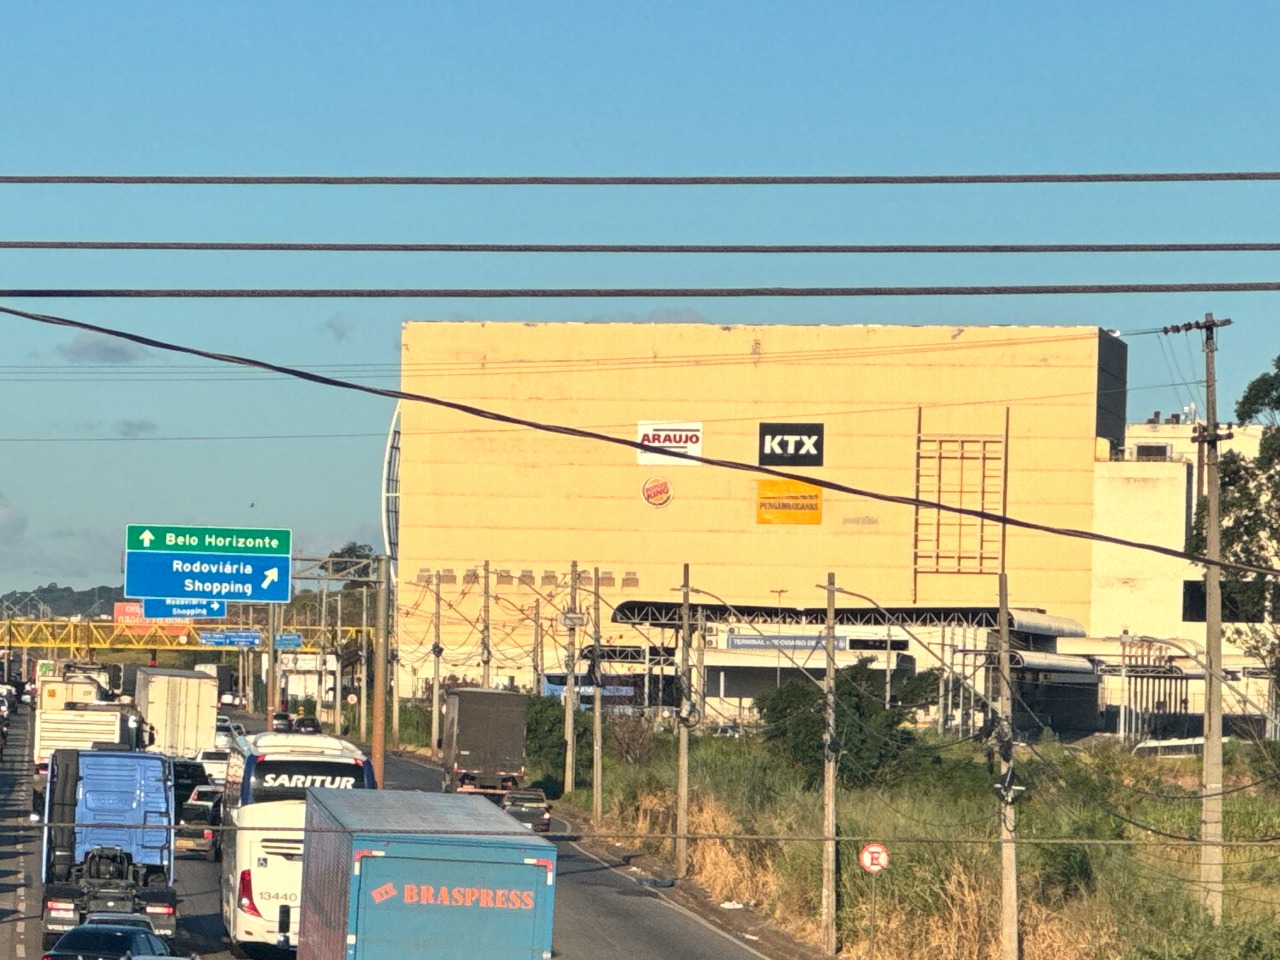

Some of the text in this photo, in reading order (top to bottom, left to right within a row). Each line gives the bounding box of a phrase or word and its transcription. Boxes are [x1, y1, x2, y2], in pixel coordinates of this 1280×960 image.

[640, 433, 700, 444] ARAUJO
[763, 434, 819, 455] KTX
[165, 533, 280, 549] Belo Horizonte
[172, 559, 253, 575] Rodoviária
[183, 578, 253, 597] Shopping
[172, 607, 207, 616] Shopping
[262, 773, 356, 790] SARITUR
[258, 891, 298, 902] 13440
[403, 883, 535, 910] BRASPRESS
